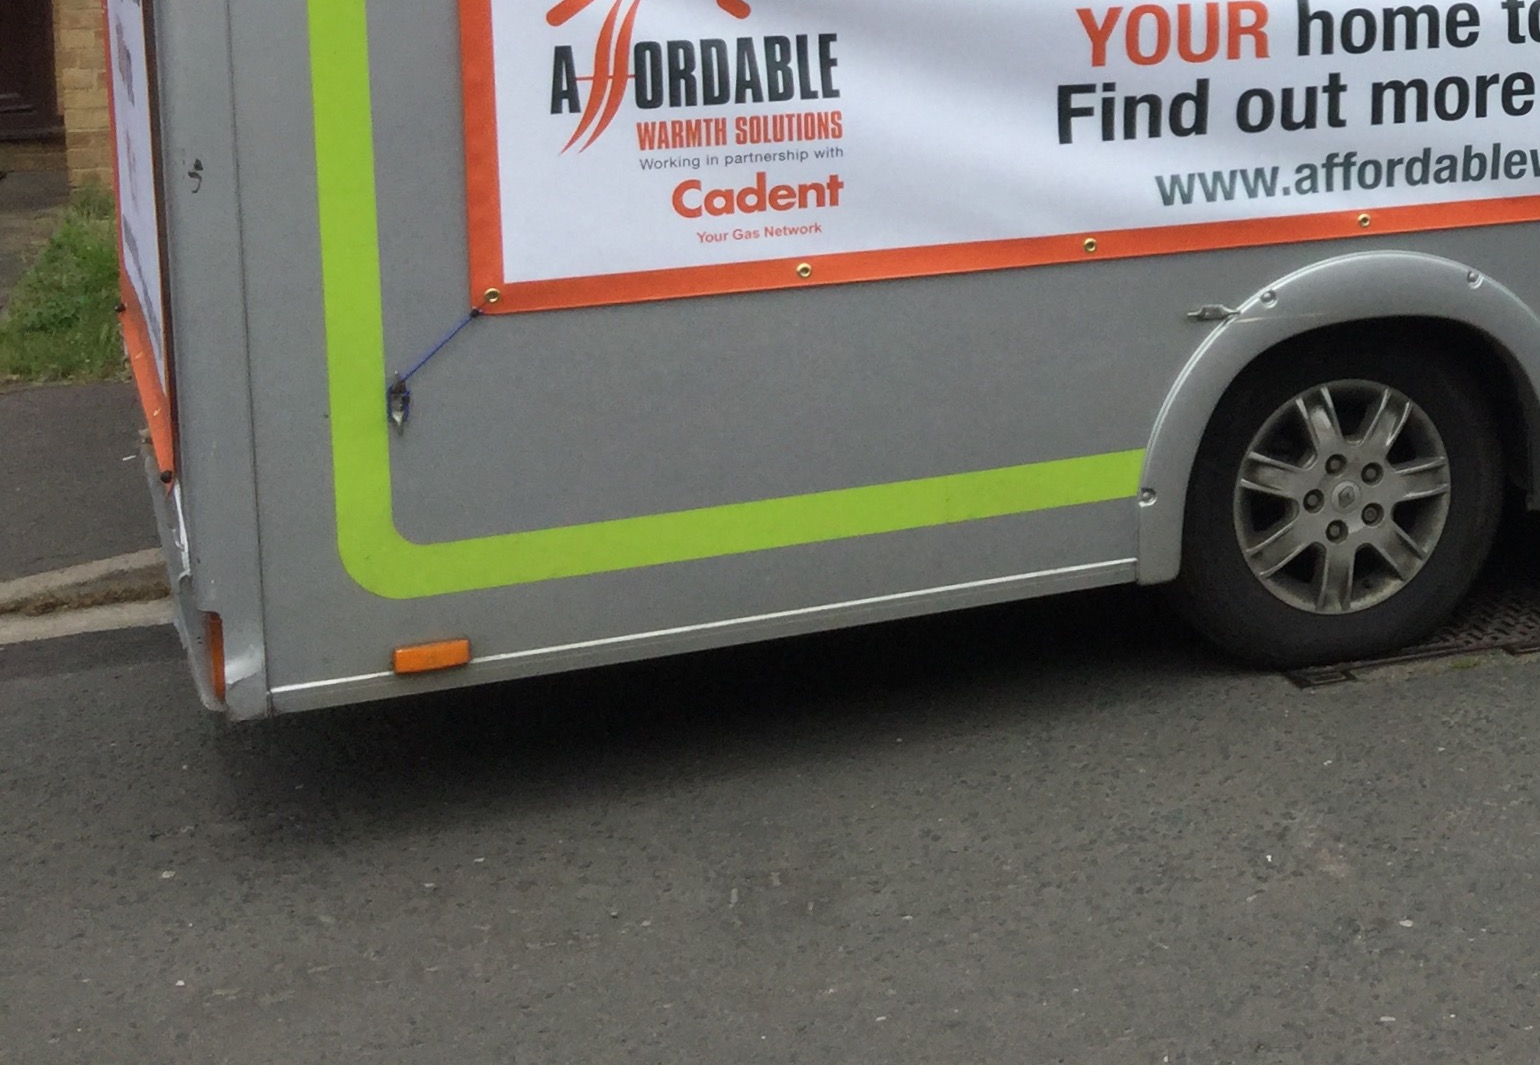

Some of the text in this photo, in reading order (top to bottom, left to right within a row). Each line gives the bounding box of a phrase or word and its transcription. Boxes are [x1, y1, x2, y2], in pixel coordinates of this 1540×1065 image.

[1076, 0, 1271, 67] YOUR
[1296, 0, 1482, 56] home
[1057, 79, 1210, 144] Find
[1236, 72, 1347, 133] out
[636, 110, 844, 151] WARMTH SOLUTIONS
[639, 146, 844, 171] Working in partnership with
[672, 171, 844, 219] Cadent
[697, 222, 823, 244] Your Gas Network
